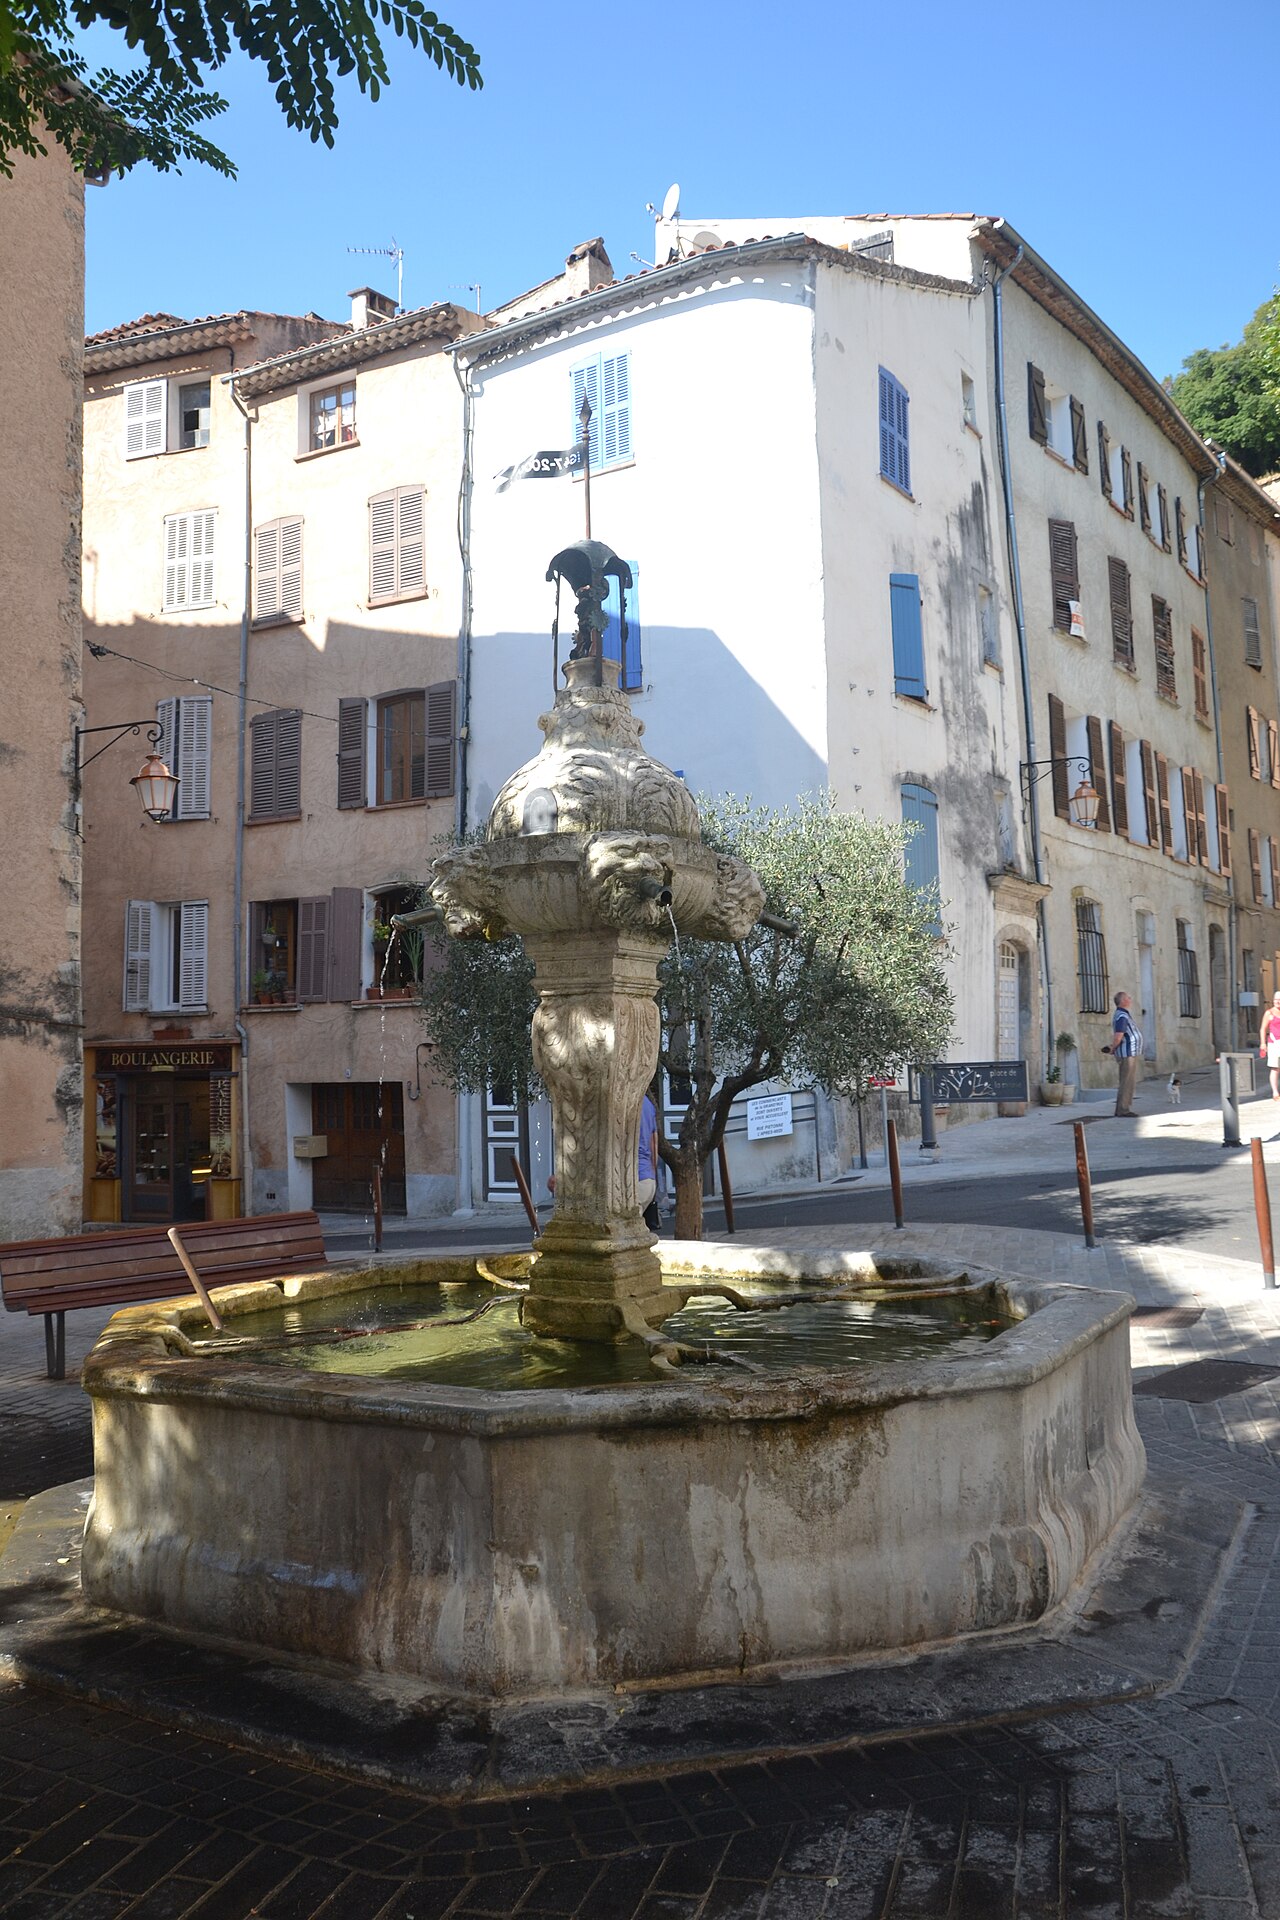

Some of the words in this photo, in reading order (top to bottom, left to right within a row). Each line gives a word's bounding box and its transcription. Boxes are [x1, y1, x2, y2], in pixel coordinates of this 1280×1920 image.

[112, 1051, 215, 1066] BOULANGERIE
[990, 1069, 1007, 1078] place
[1008, 1068, 1017, 1077] de
